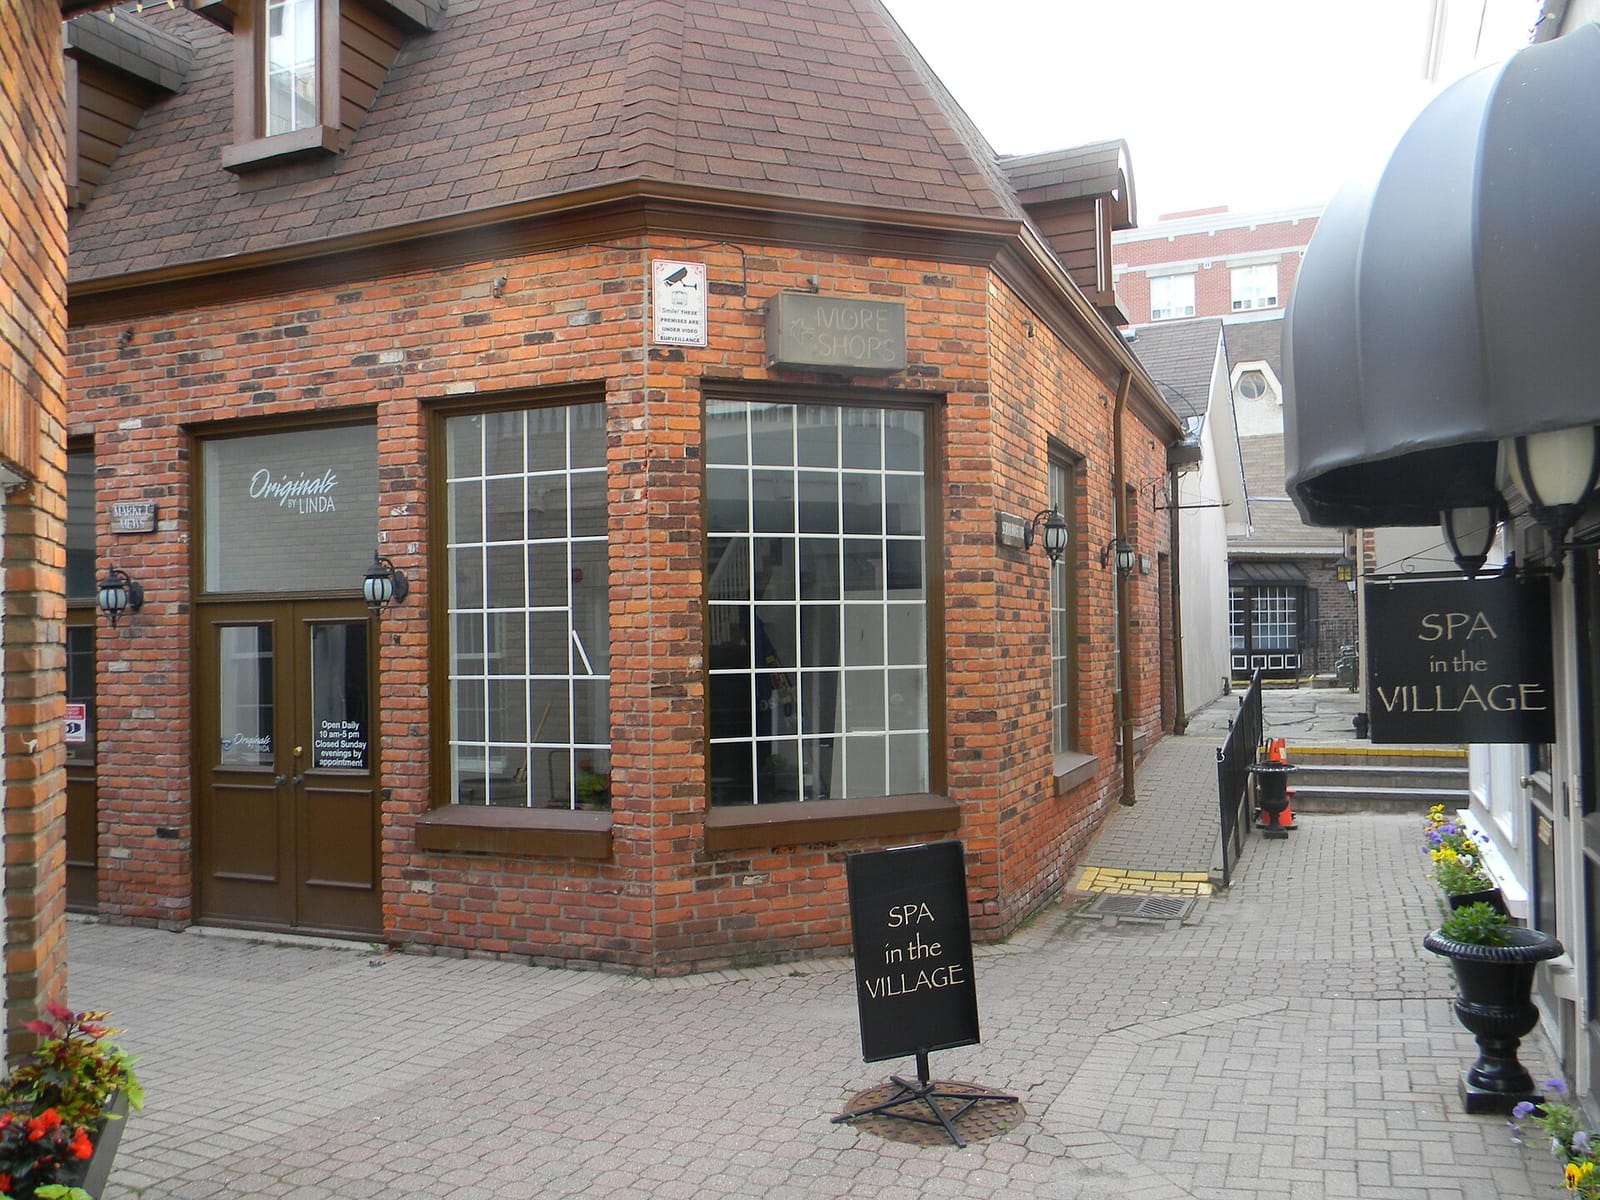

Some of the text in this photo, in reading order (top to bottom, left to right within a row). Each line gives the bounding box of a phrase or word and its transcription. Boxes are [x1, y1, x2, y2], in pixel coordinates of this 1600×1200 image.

[816, 305, 889, 334] MORE
[817, 334, 896, 362] SHOPS
[249, 468, 339, 507] Originals
[287, 495, 336, 514] BY LINDA
[1418, 611, 1497, 641] SPA
[1429, 649, 1488, 673] in the
[1376, 683, 1547, 713] VILLAGE
[319, 730, 328, 738] 10
[321, 720, 360, 730] Open Daily
[315, 739, 367, 750] Closed Sunday
[320, 749, 362, 759] evenings by
[319, 758, 363, 768] appointment
[888, 902, 934, 927] SPA
[885, 932, 942, 964] in the
[865, 964, 964, 998] VILLAGE
